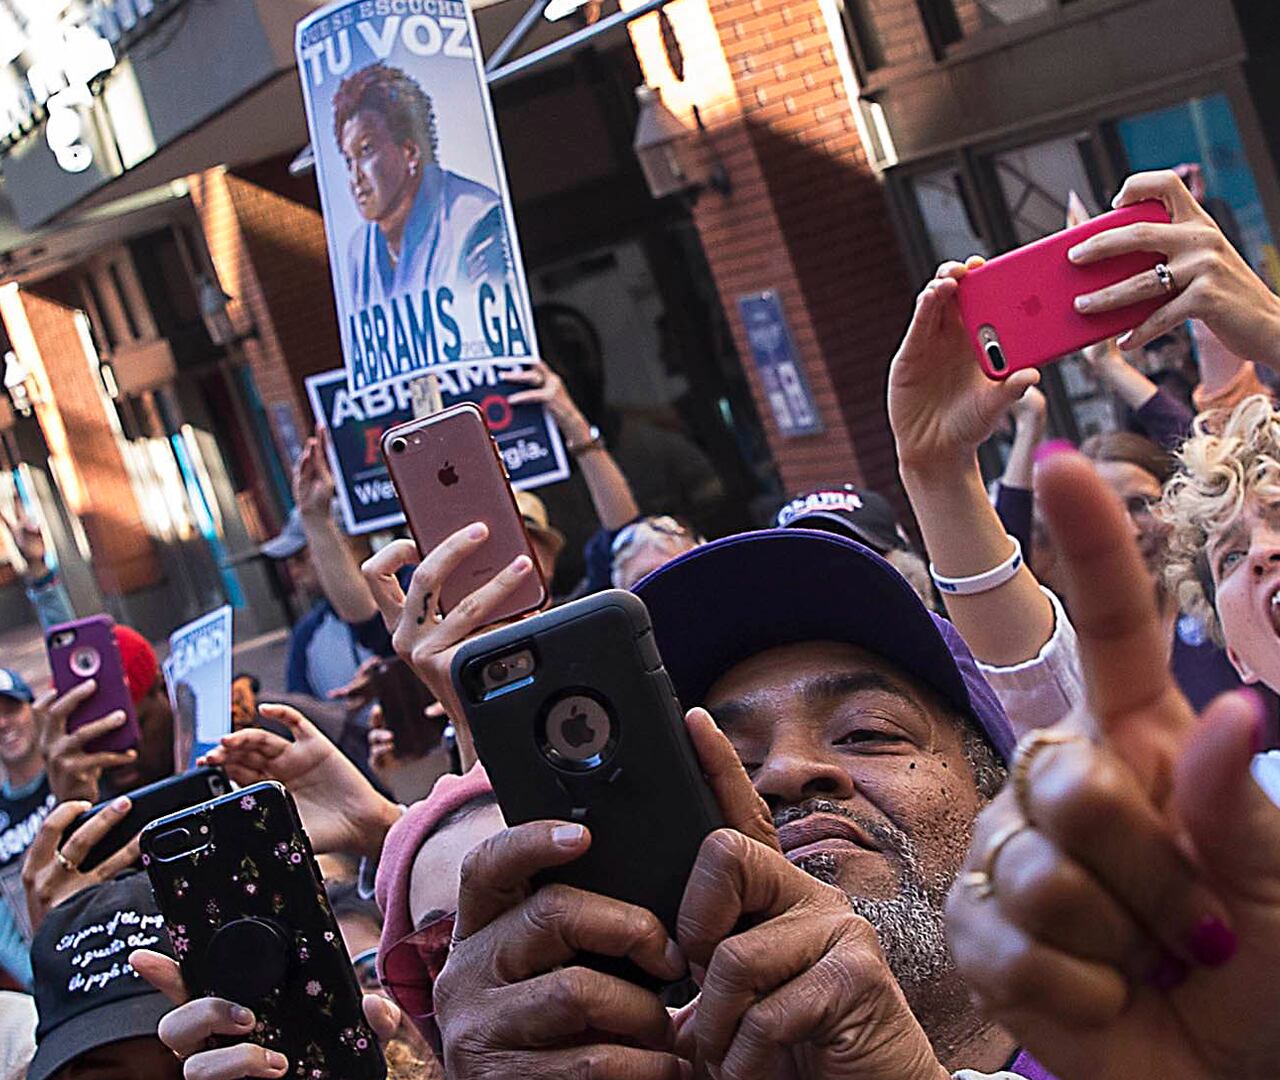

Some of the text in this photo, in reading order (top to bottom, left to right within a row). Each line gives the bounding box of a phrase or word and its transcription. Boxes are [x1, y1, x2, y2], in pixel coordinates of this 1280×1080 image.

[302, 15, 473, 86] TU VOZ
[349, 286, 462, 393] ABRAMS
[478, 282, 532, 358] GA
[173, 629, 224, 679] EARD
